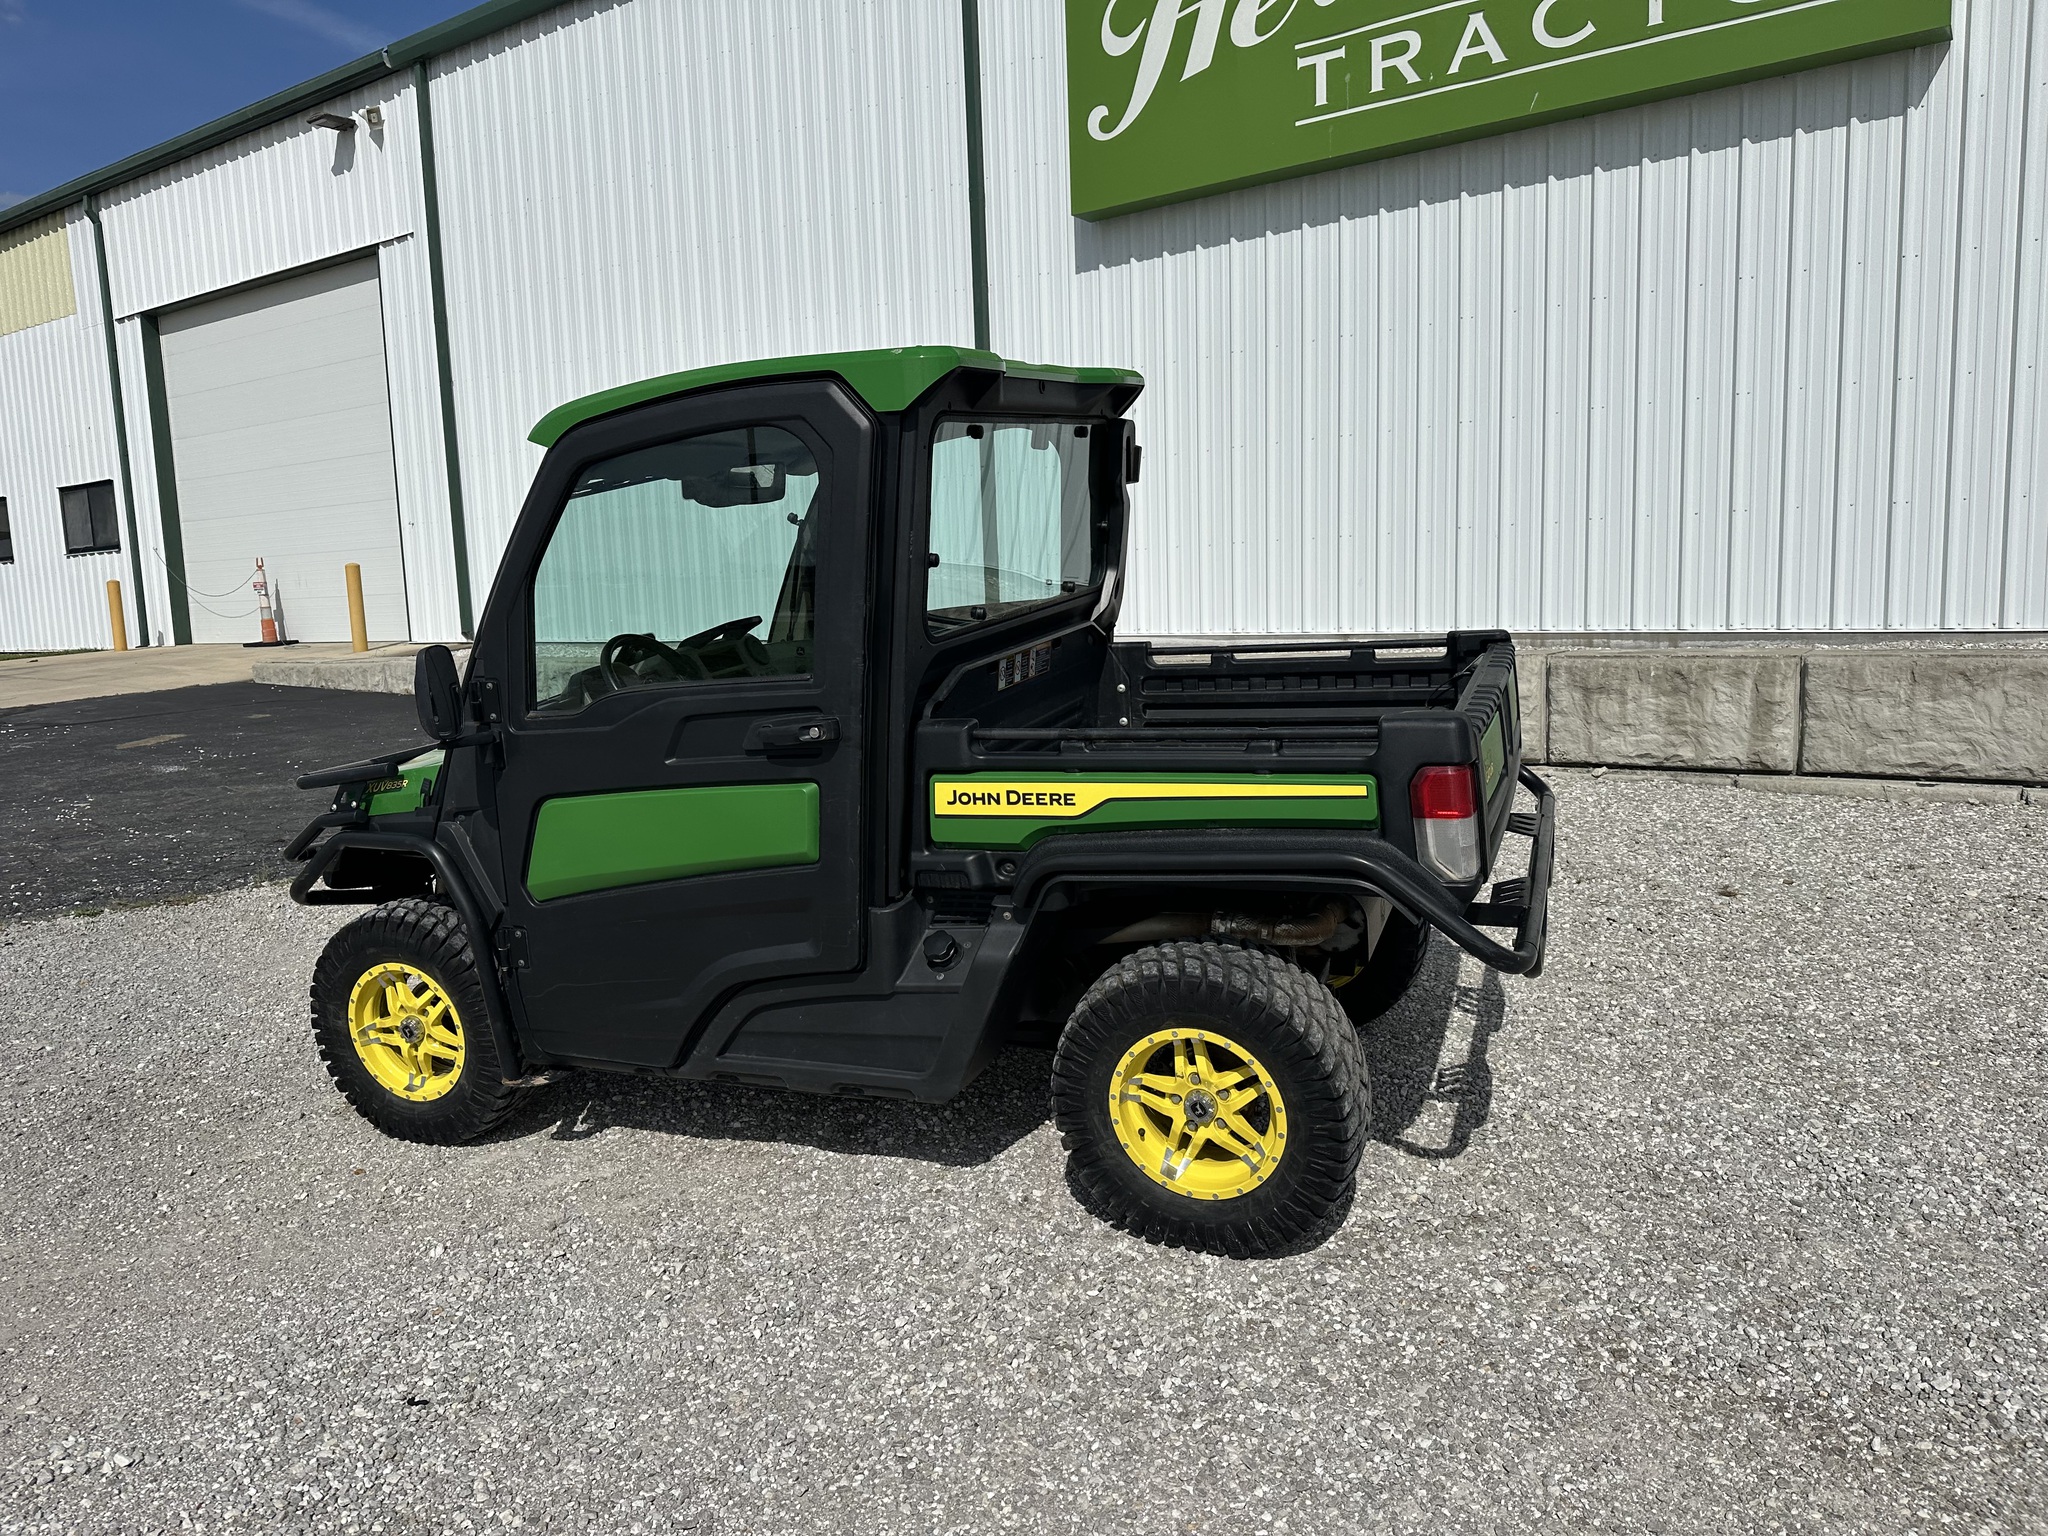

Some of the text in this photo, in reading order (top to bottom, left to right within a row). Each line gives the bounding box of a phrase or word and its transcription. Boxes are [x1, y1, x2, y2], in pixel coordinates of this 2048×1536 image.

[1297, 0, 1764, 107] TRAC
[365, 779, 409, 794] XUV835R
[946, 789, 1076, 806] JOHN DEERE
